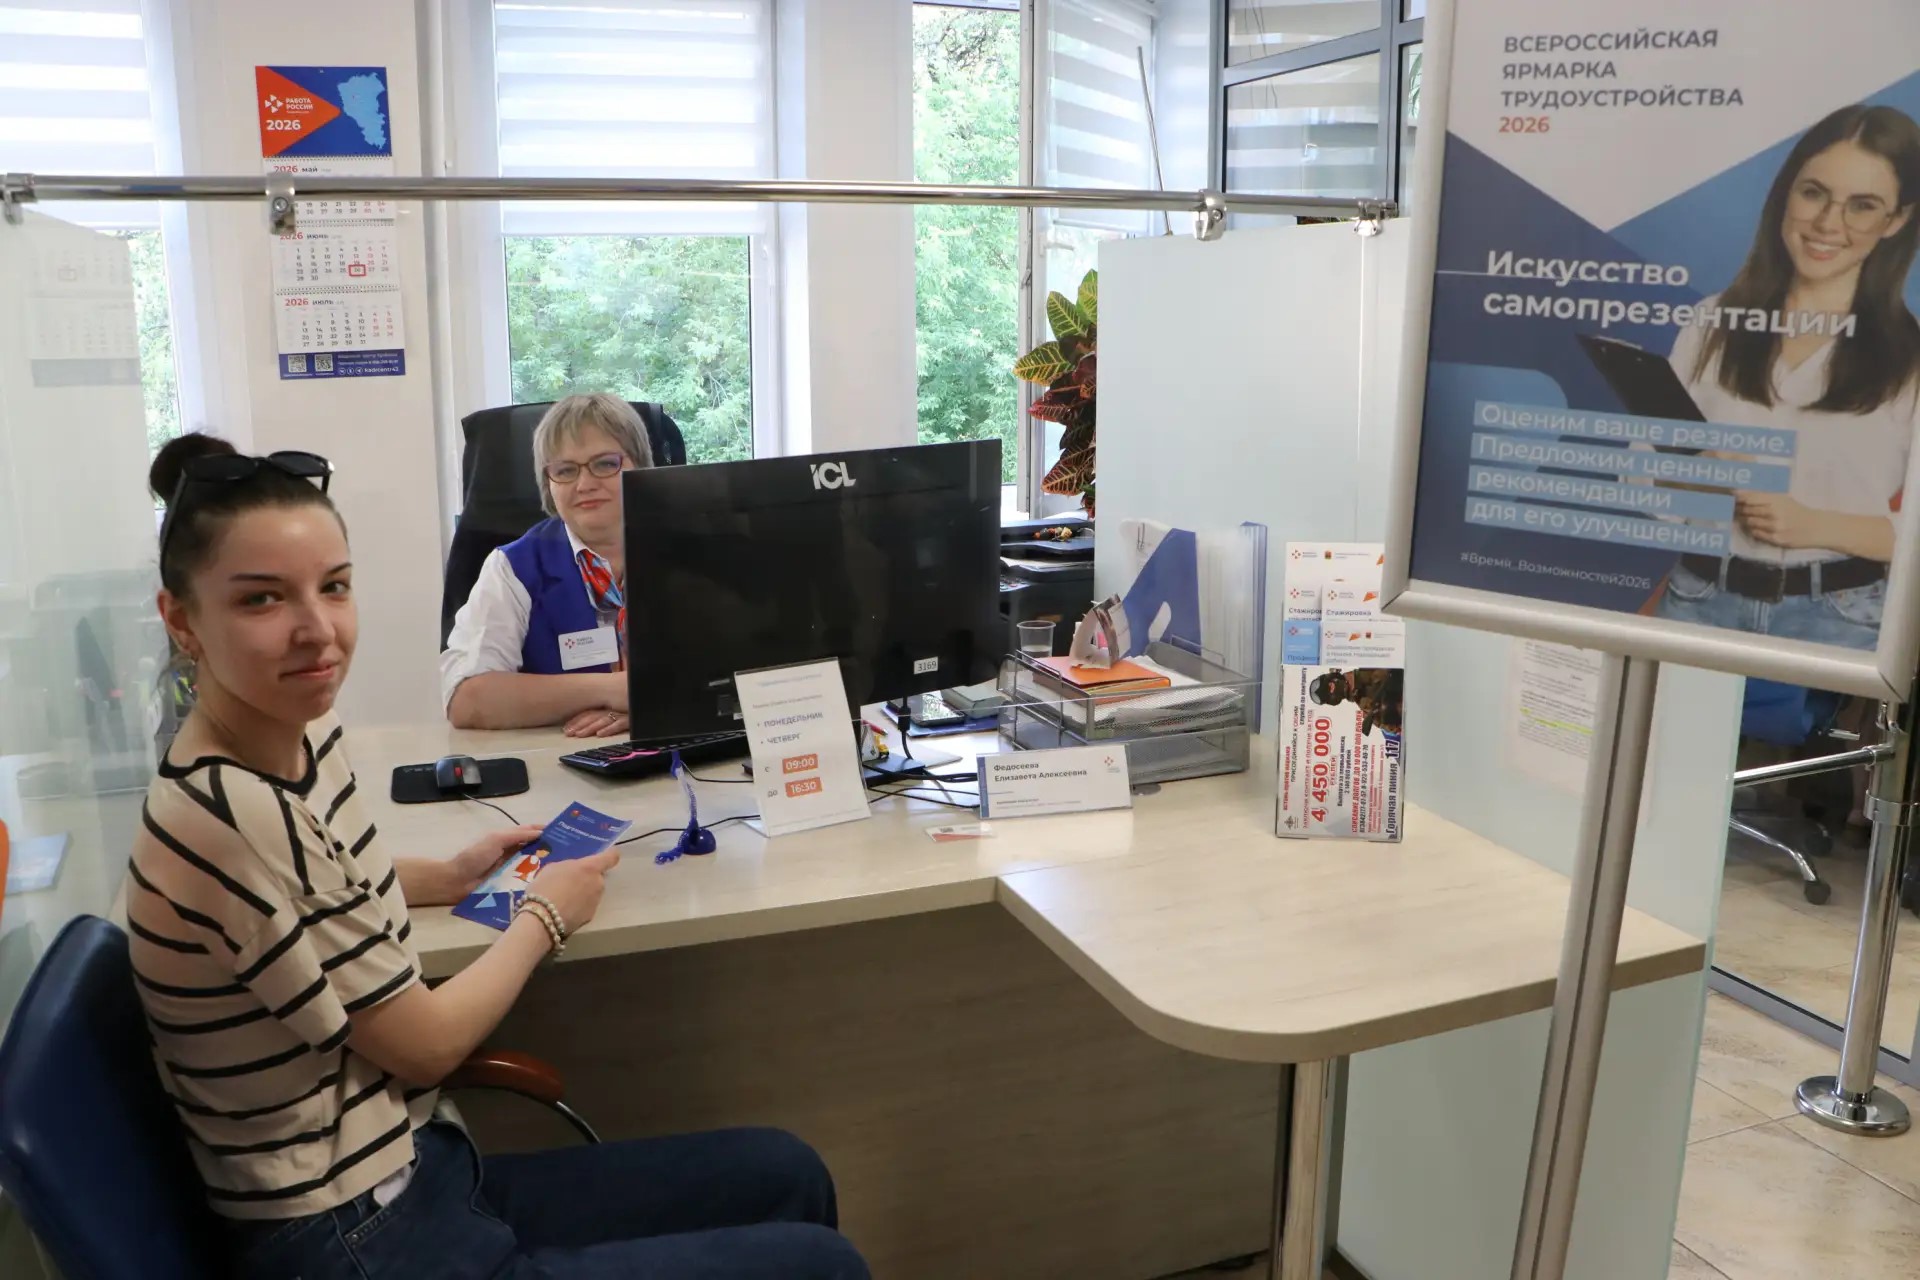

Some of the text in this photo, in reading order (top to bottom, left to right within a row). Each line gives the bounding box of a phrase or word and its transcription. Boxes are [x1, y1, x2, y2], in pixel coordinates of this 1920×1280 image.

[1503, 28, 1719, 53] ВСЕРОССИЙСКАЯ
[1502, 61, 1617, 80] ЯРМАРКА
[1501, 85, 1744, 110] ТРУДОУСТРОЙСТВА
[266, 119, 301, 130] 2026
[1498, 116, 1551, 133] 2026
[1487, 250, 1689, 287] Искусство
[284, 298, 309, 306] 2026
[1483, 292, 1858, 338] самопрезентации
[1482, 404, 1792, 454] Оценим ваше резюме.
[1480, 436, 1750, 484] Предложим ценные
[1476, 471, 1672, 508] рекомендации
[1471, 502, 1724, 549] для его улучшения
[1460, 551, 1651, 590] #Время_Возможностей2026
[918, 661, 936, 671] 3169
[764, 712, 823, 728] ПОНЕДЕЛЬНИК
[767, 733, 802, 744] ЧЕТВЕРГ
[786, 758, 815, 770] 09:00
[994, 762, 1039, 772] Федосеева
[1311, 718, 1329, 822] 4 450 000
[994, 769, 1087, 782] Елизавета Алексеевна
[790, 781, 817, 793] 16:30
[1385, 740, 1398, 834] Горячая линия 117
